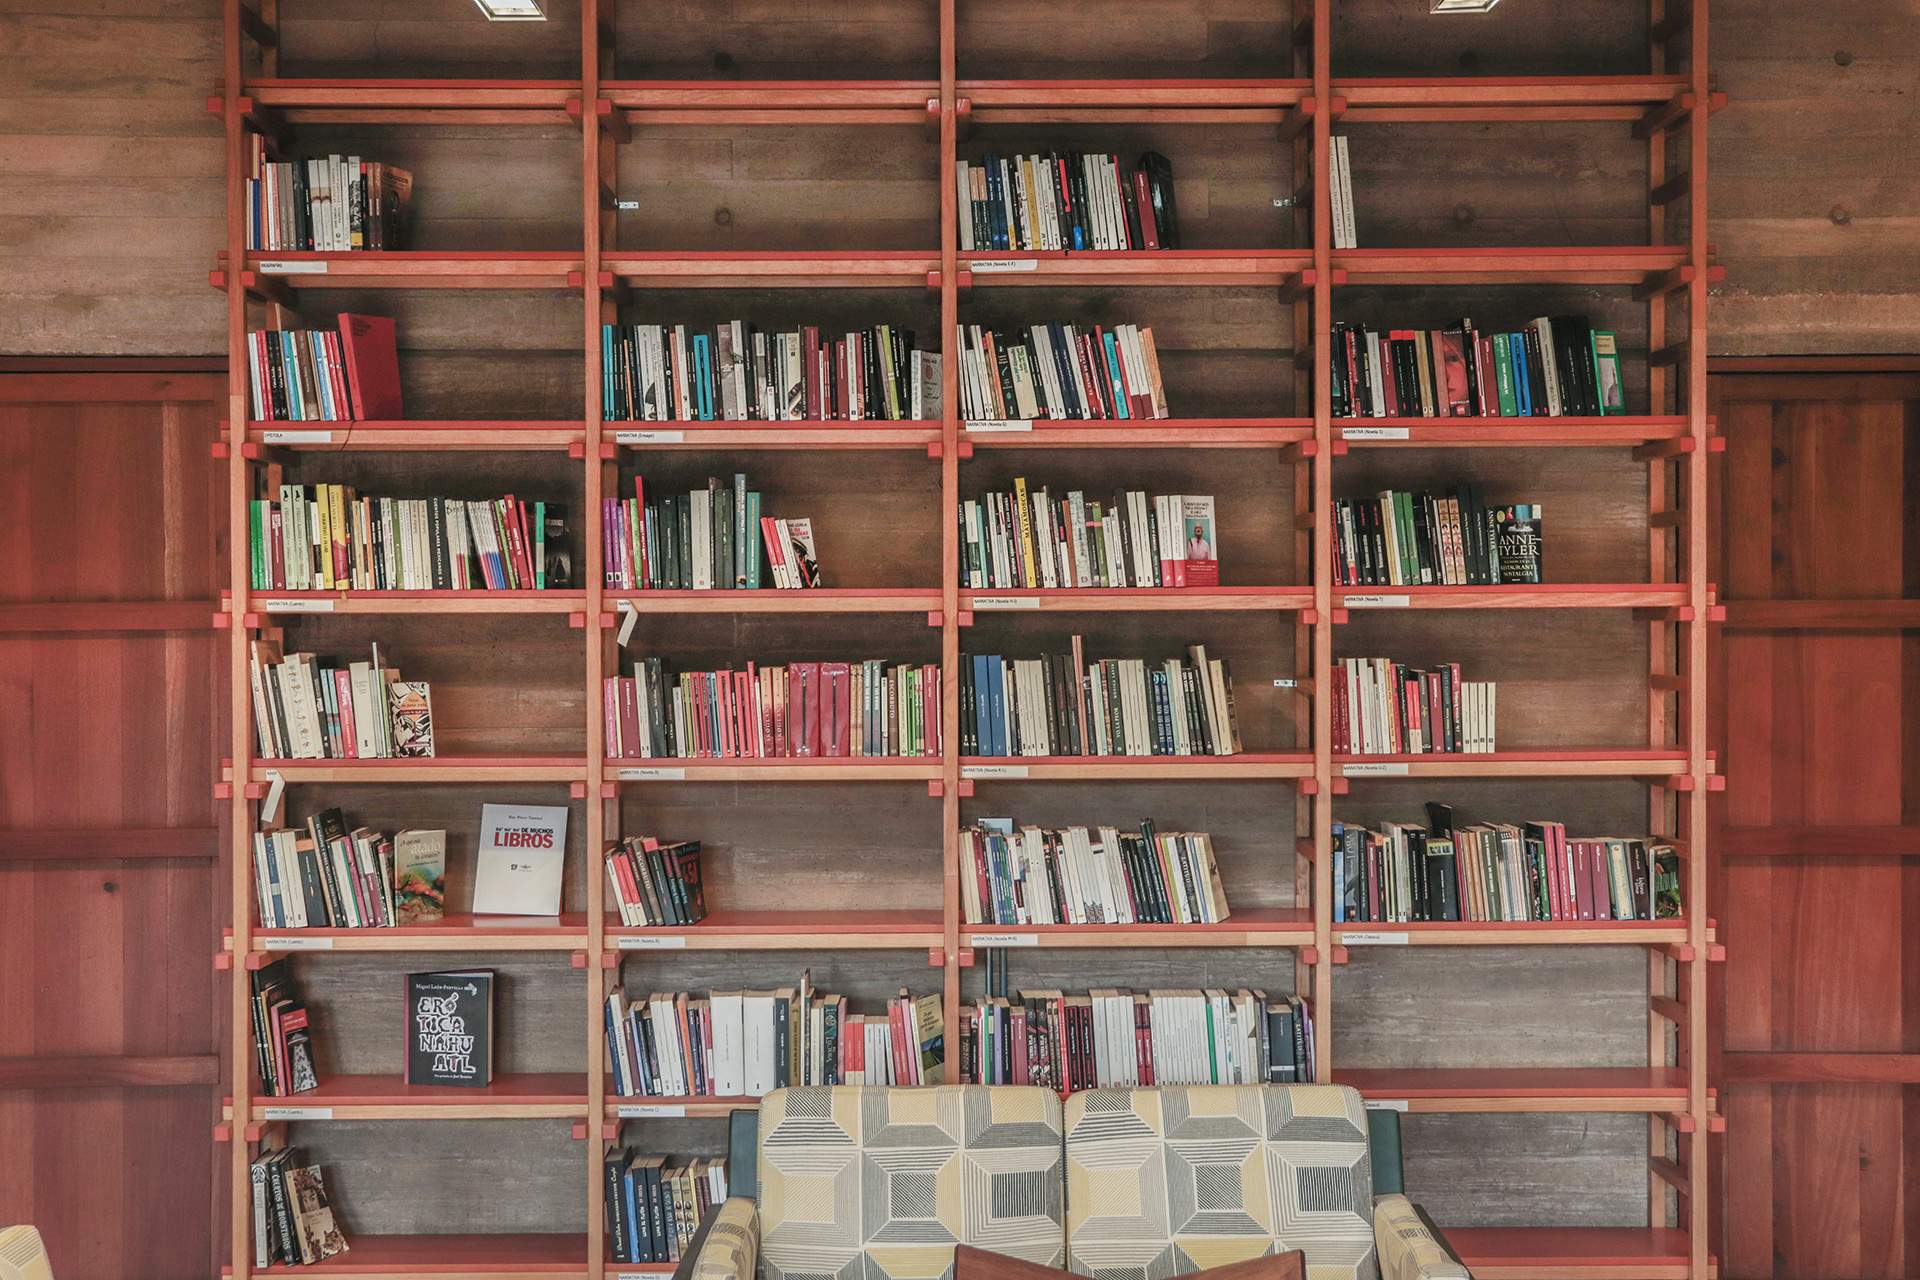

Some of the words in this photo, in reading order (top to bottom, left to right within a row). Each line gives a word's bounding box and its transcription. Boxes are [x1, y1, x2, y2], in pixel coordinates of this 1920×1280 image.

[1019, 487, 1031, 539] MATAMOSCAS
[1486, 509, 1495, 528] ANNE
[1487, 528, 1497, 550] TYLER
[1499, 544, 1540, 556] TYLER
[1500, 534, 1537, 545] ANNE
[886, 679, 897, 718] ESCORBUTO
[762, 702, 772, 741] SKOGLAND
[411, 838, 441, 855] atado
[494, 832, 554, 849] LIBROS
[633, 850, 654, 889] ESCORBUTO
[1179, 855, 1192, 883] LATITUD
[418, 991, 460, 1016] ERÓ
[416, 1015, 465, 1035] TICA
[419, 1033, 474, 1054] NÁHU
[821, 1035, 837, 1062] LECTORA
[1293, 1023, 1304, 1051] LATITUD
[432, 1053, 476, 1073] ATL
[276, 1210, 292, 1250] MONSTRUOS
